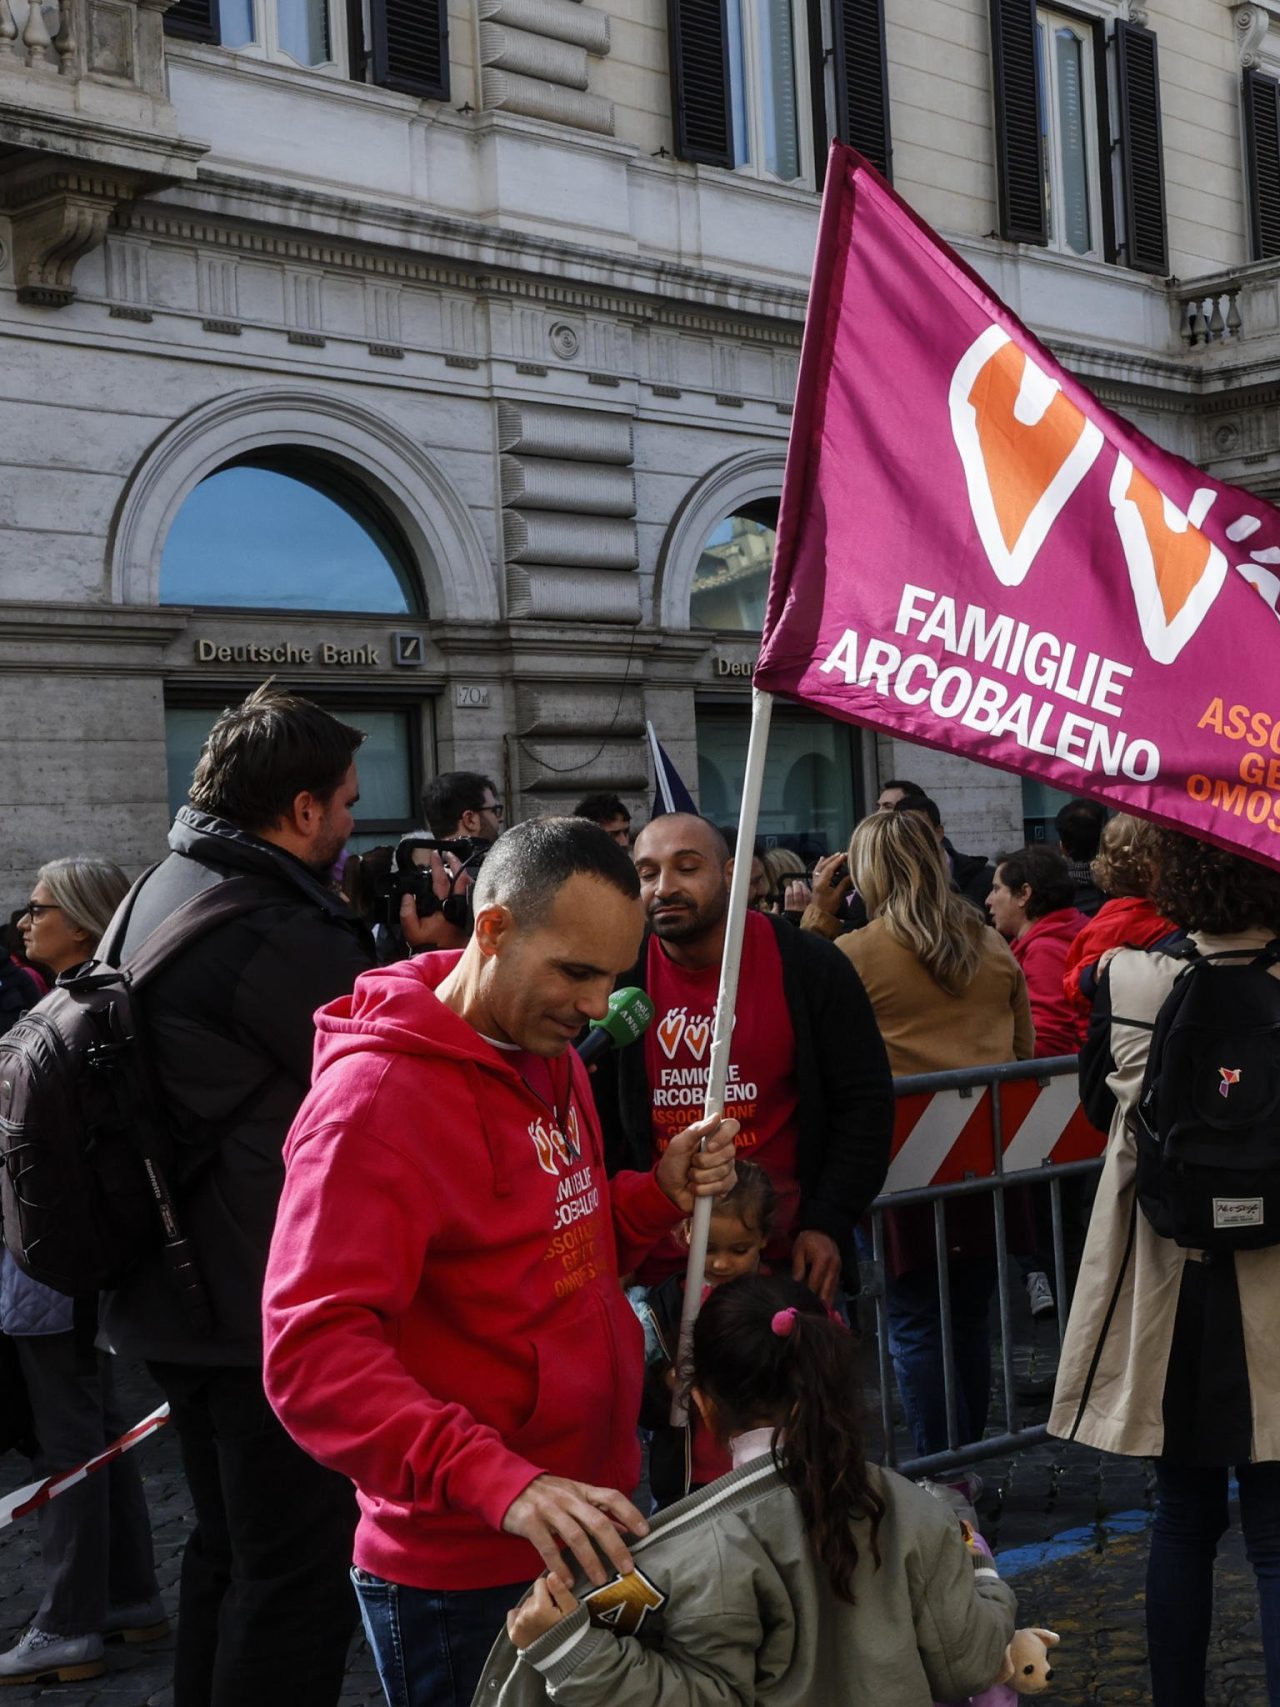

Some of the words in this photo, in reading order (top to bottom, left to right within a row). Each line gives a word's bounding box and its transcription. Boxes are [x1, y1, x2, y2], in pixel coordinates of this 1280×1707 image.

[197, 639, 313, 664] Deutsche
[322, 643, 380, 665] Bank
[895, 583, 1134, 717] FAMIGLIE
[819, 628, 1160, 782] ARCOBALENO
[620, 1009, 640, 1037] ANSA
[661, 1064, 740, 1086] FAMIE
[653, 1083, 757, 1106] RCOBENO
